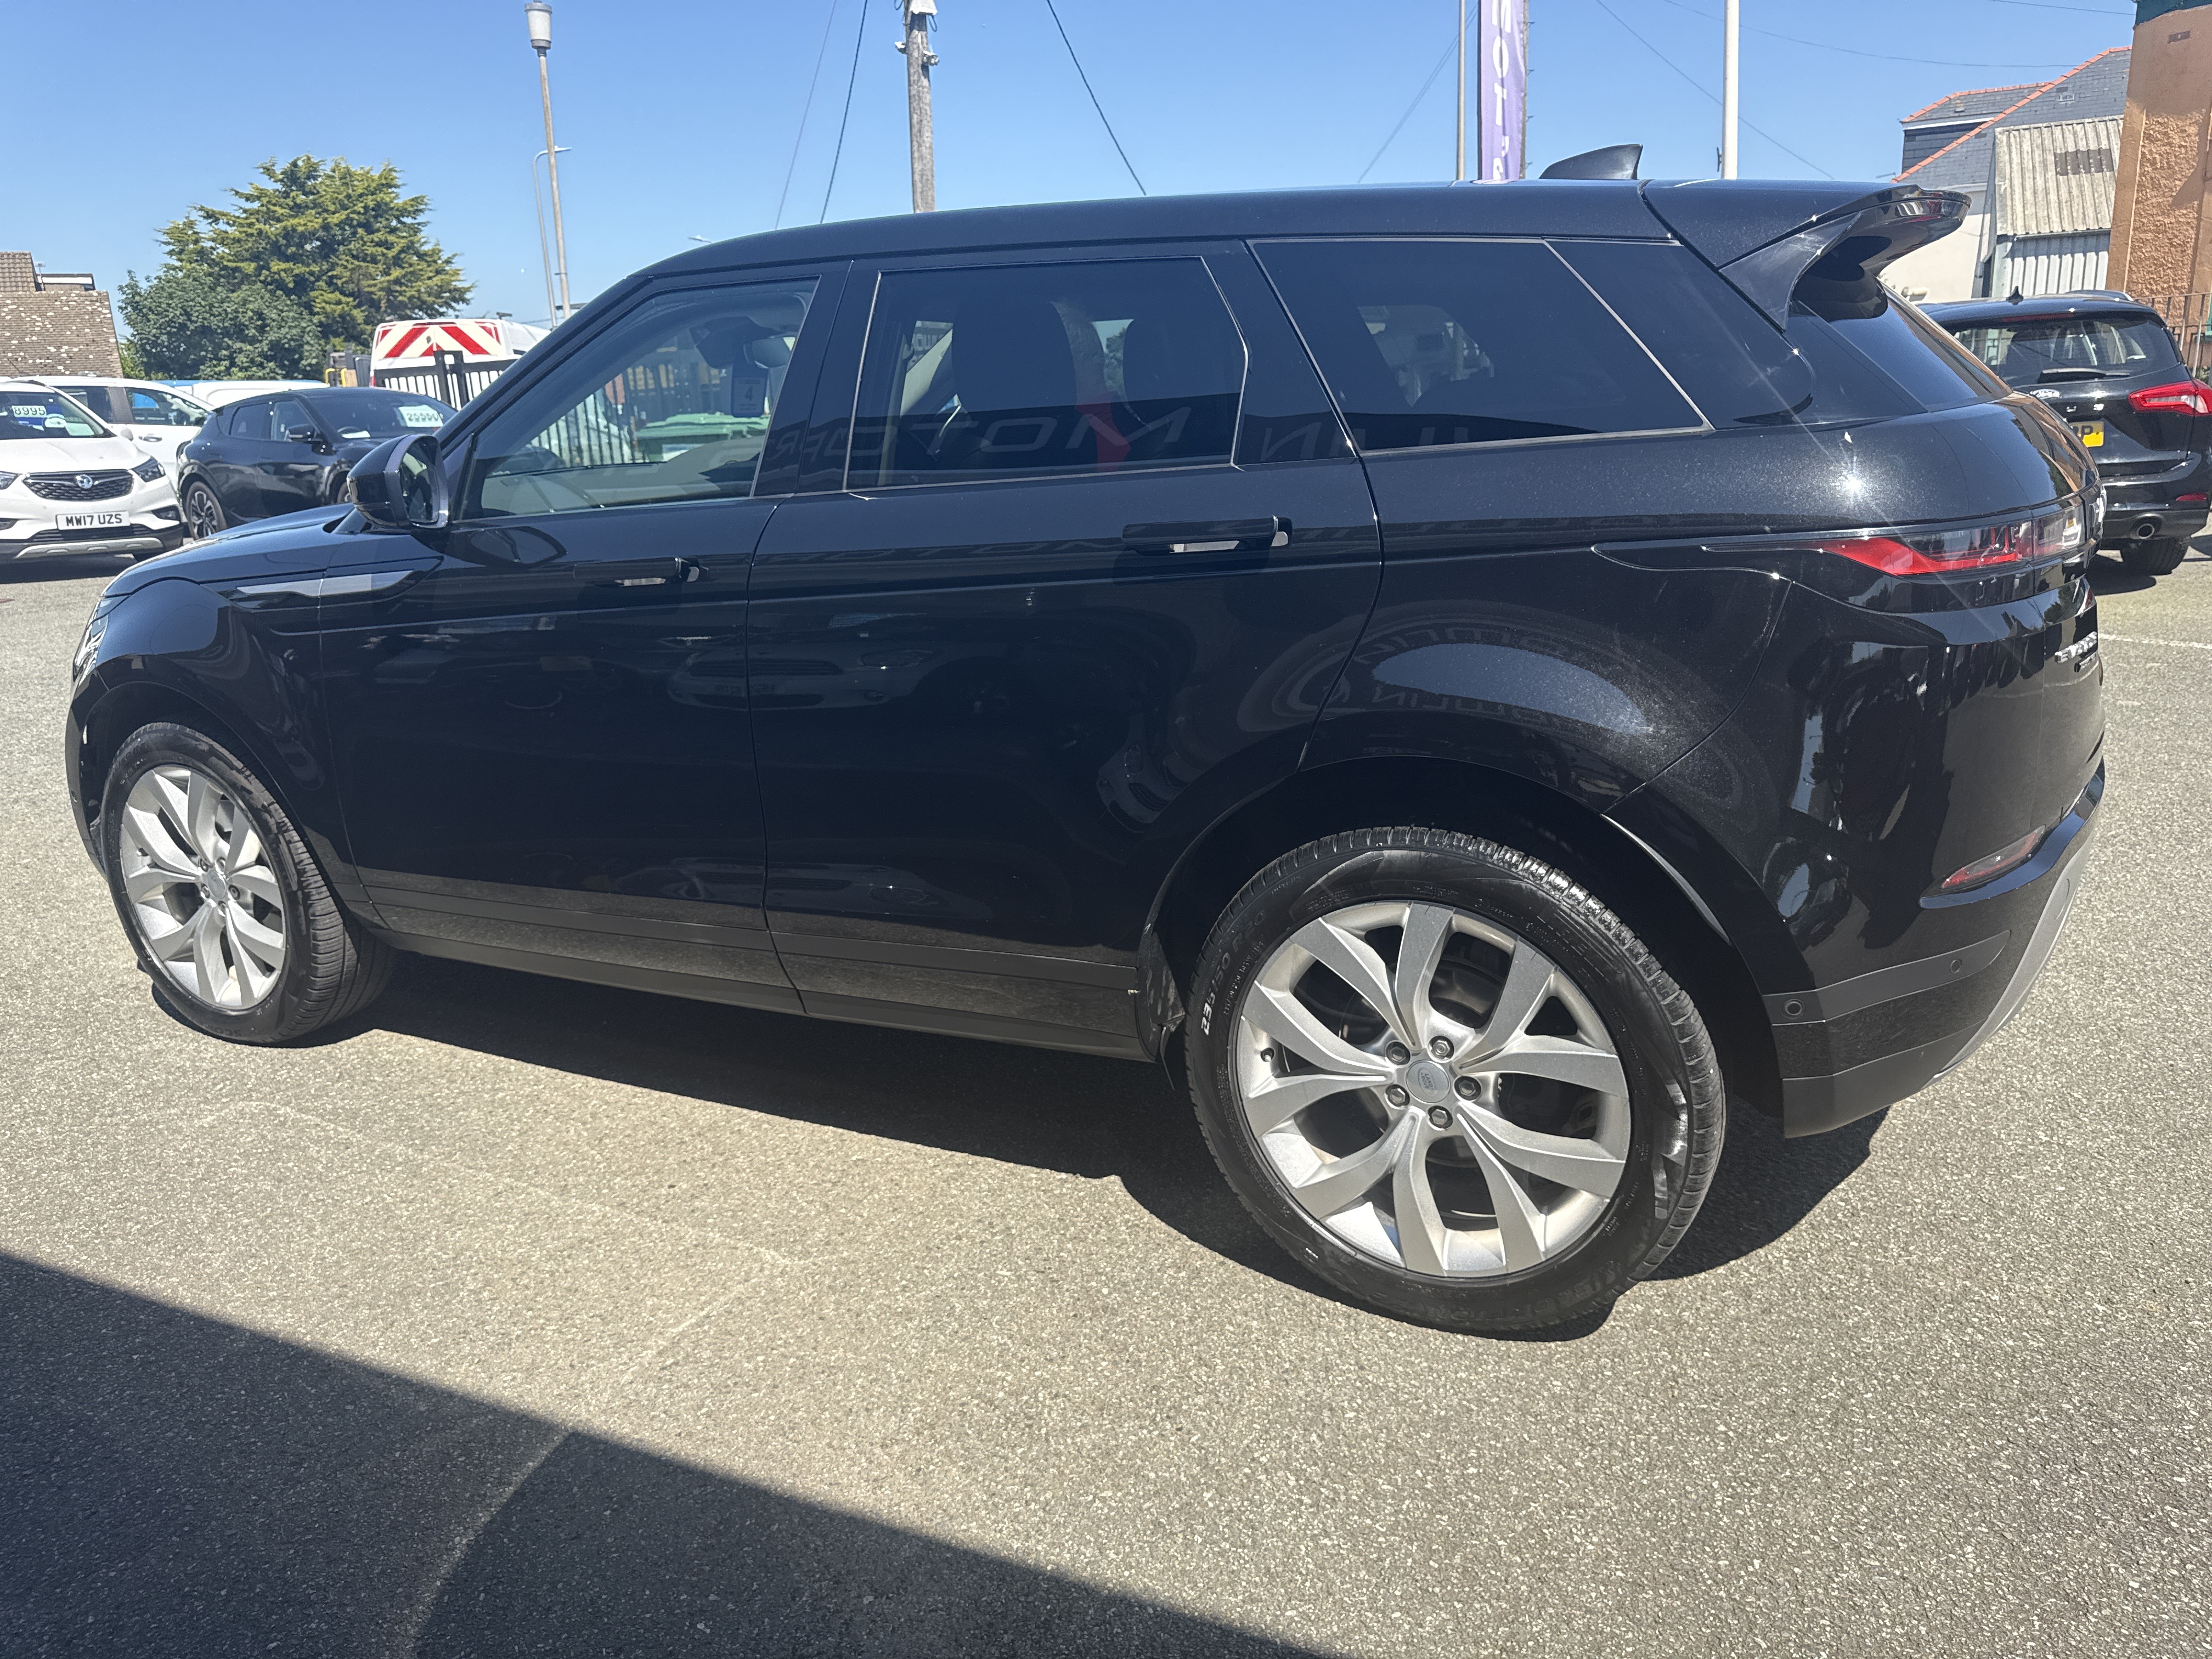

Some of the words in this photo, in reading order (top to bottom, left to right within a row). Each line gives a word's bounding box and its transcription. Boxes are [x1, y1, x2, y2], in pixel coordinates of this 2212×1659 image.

[14, 407, 46, 416] 8995
[66, 515, 94, 527] MW17
[98, 514, 122, 524] UZS
